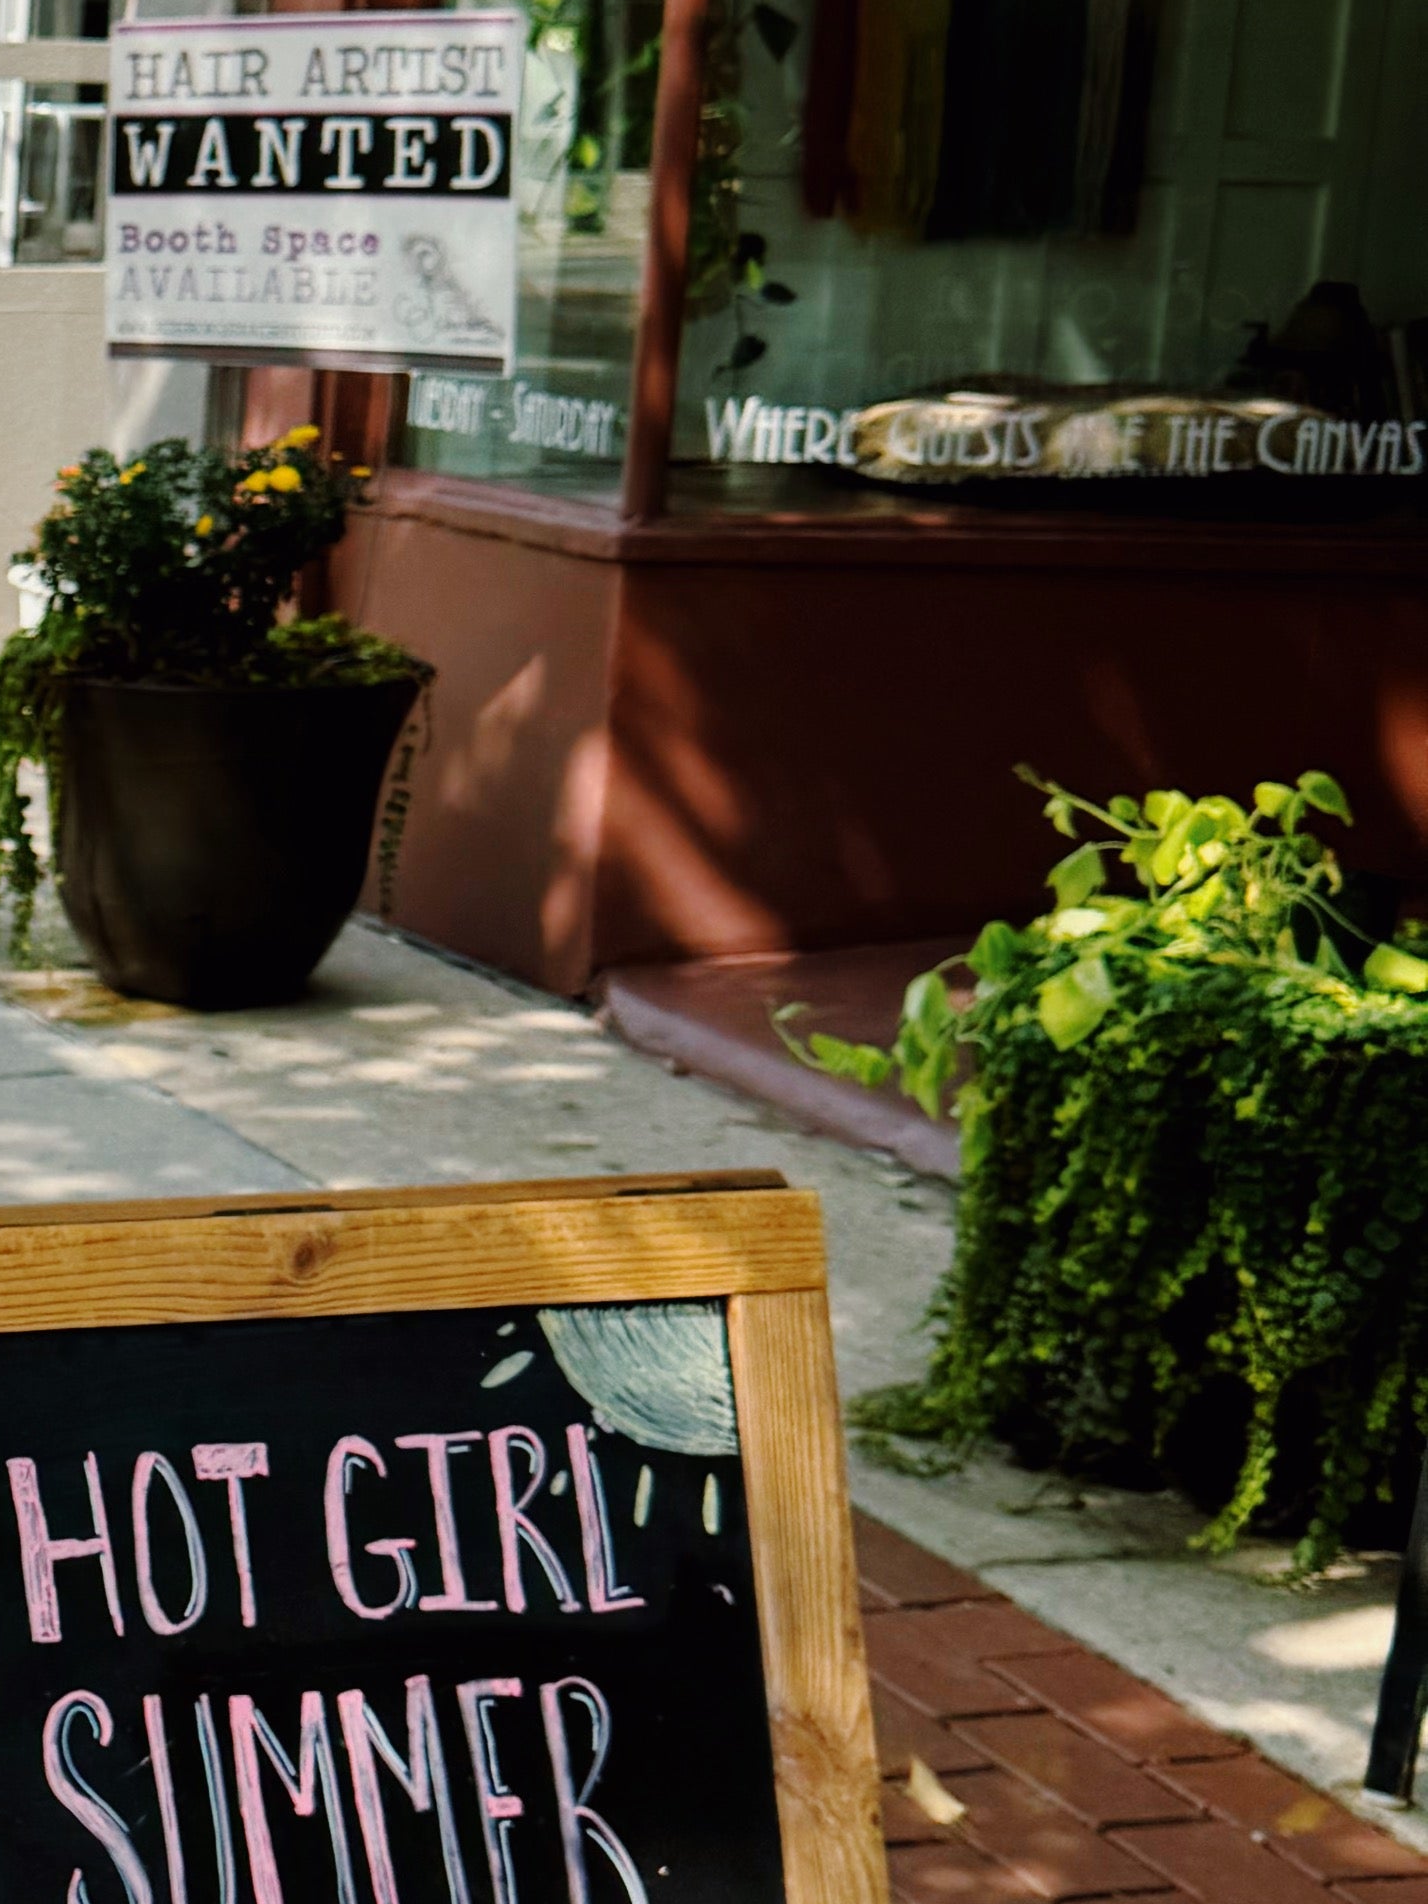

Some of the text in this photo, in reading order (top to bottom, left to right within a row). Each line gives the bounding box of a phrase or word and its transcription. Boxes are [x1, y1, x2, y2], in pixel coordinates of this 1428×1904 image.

[126, 44, 504, 100] HAIR ARTIST
[124, 117, 504, 190] WANTED
[118, 223, 380, 261] Booth Space
[116, 266, 379, 307] AVAILABLE
[6, 1424, 647, 1643] HOT GIRL
